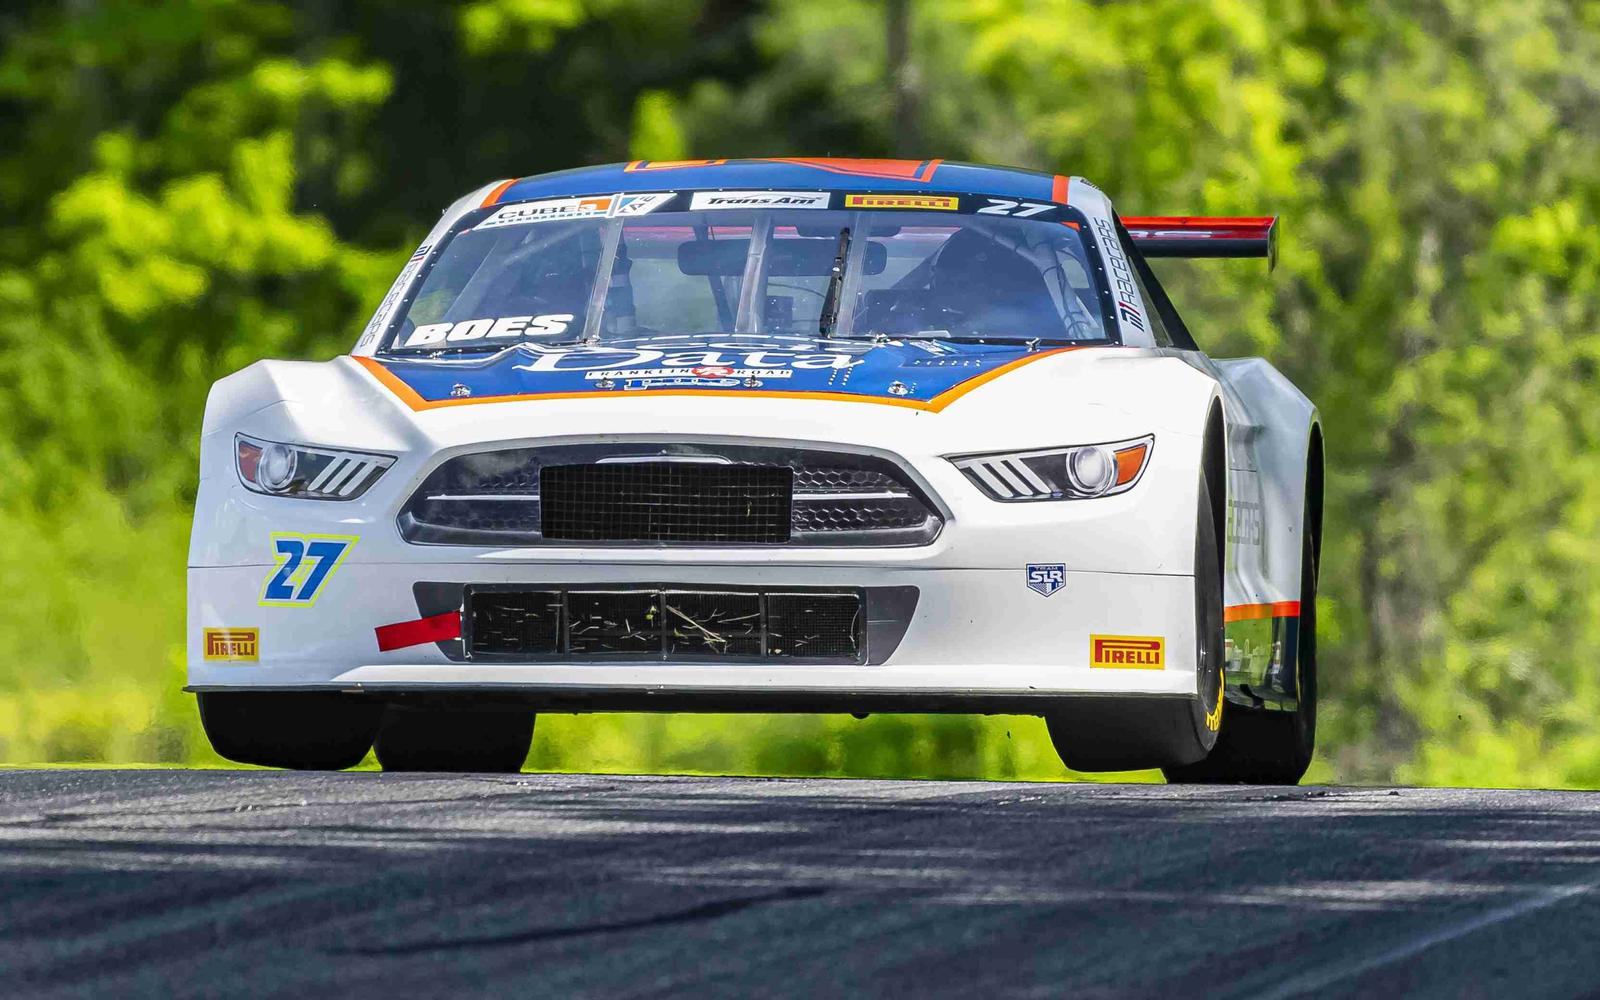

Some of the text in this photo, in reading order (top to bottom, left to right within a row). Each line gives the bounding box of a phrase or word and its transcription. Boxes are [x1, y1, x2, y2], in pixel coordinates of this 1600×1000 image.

[852, 197, 951, 208] PIRELLI
[977, 198, 1055, 217] 27
[512, 347, 865, 372] Data
[262, 537, 352, 602] 27
[1030, 570, 1063, 583] SLR
[207, 632, 255, 656] PIRELLI
[1095, 639, 1161, 665] PIRELLI
